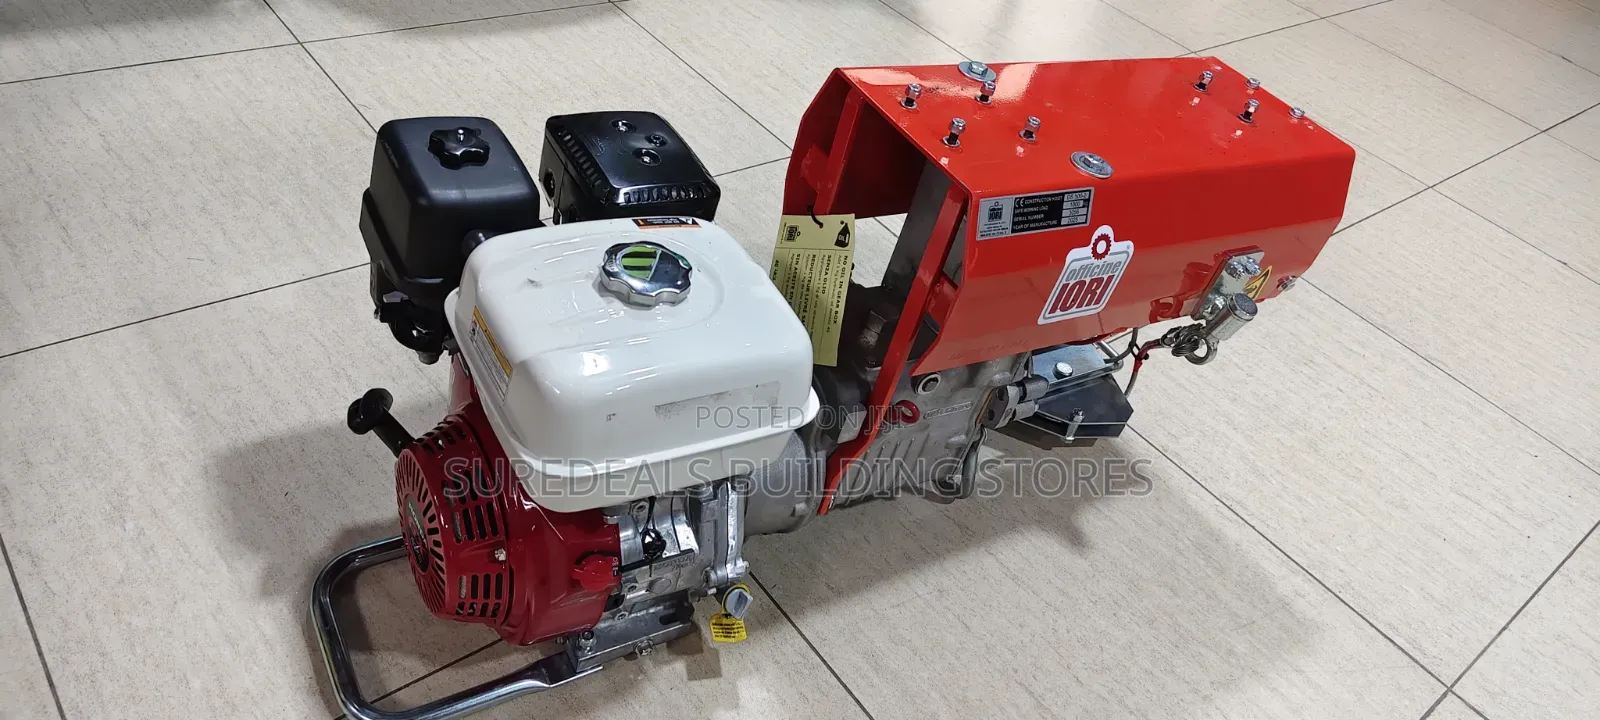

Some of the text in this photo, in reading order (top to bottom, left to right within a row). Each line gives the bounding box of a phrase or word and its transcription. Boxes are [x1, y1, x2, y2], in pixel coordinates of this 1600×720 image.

[806, 254, 816, 292] REDUCTEUR
[843, 255, 848, 265] NO
[1065, 260, 1122, 282] officine
[1048, 274, 1116, 314] IORI
